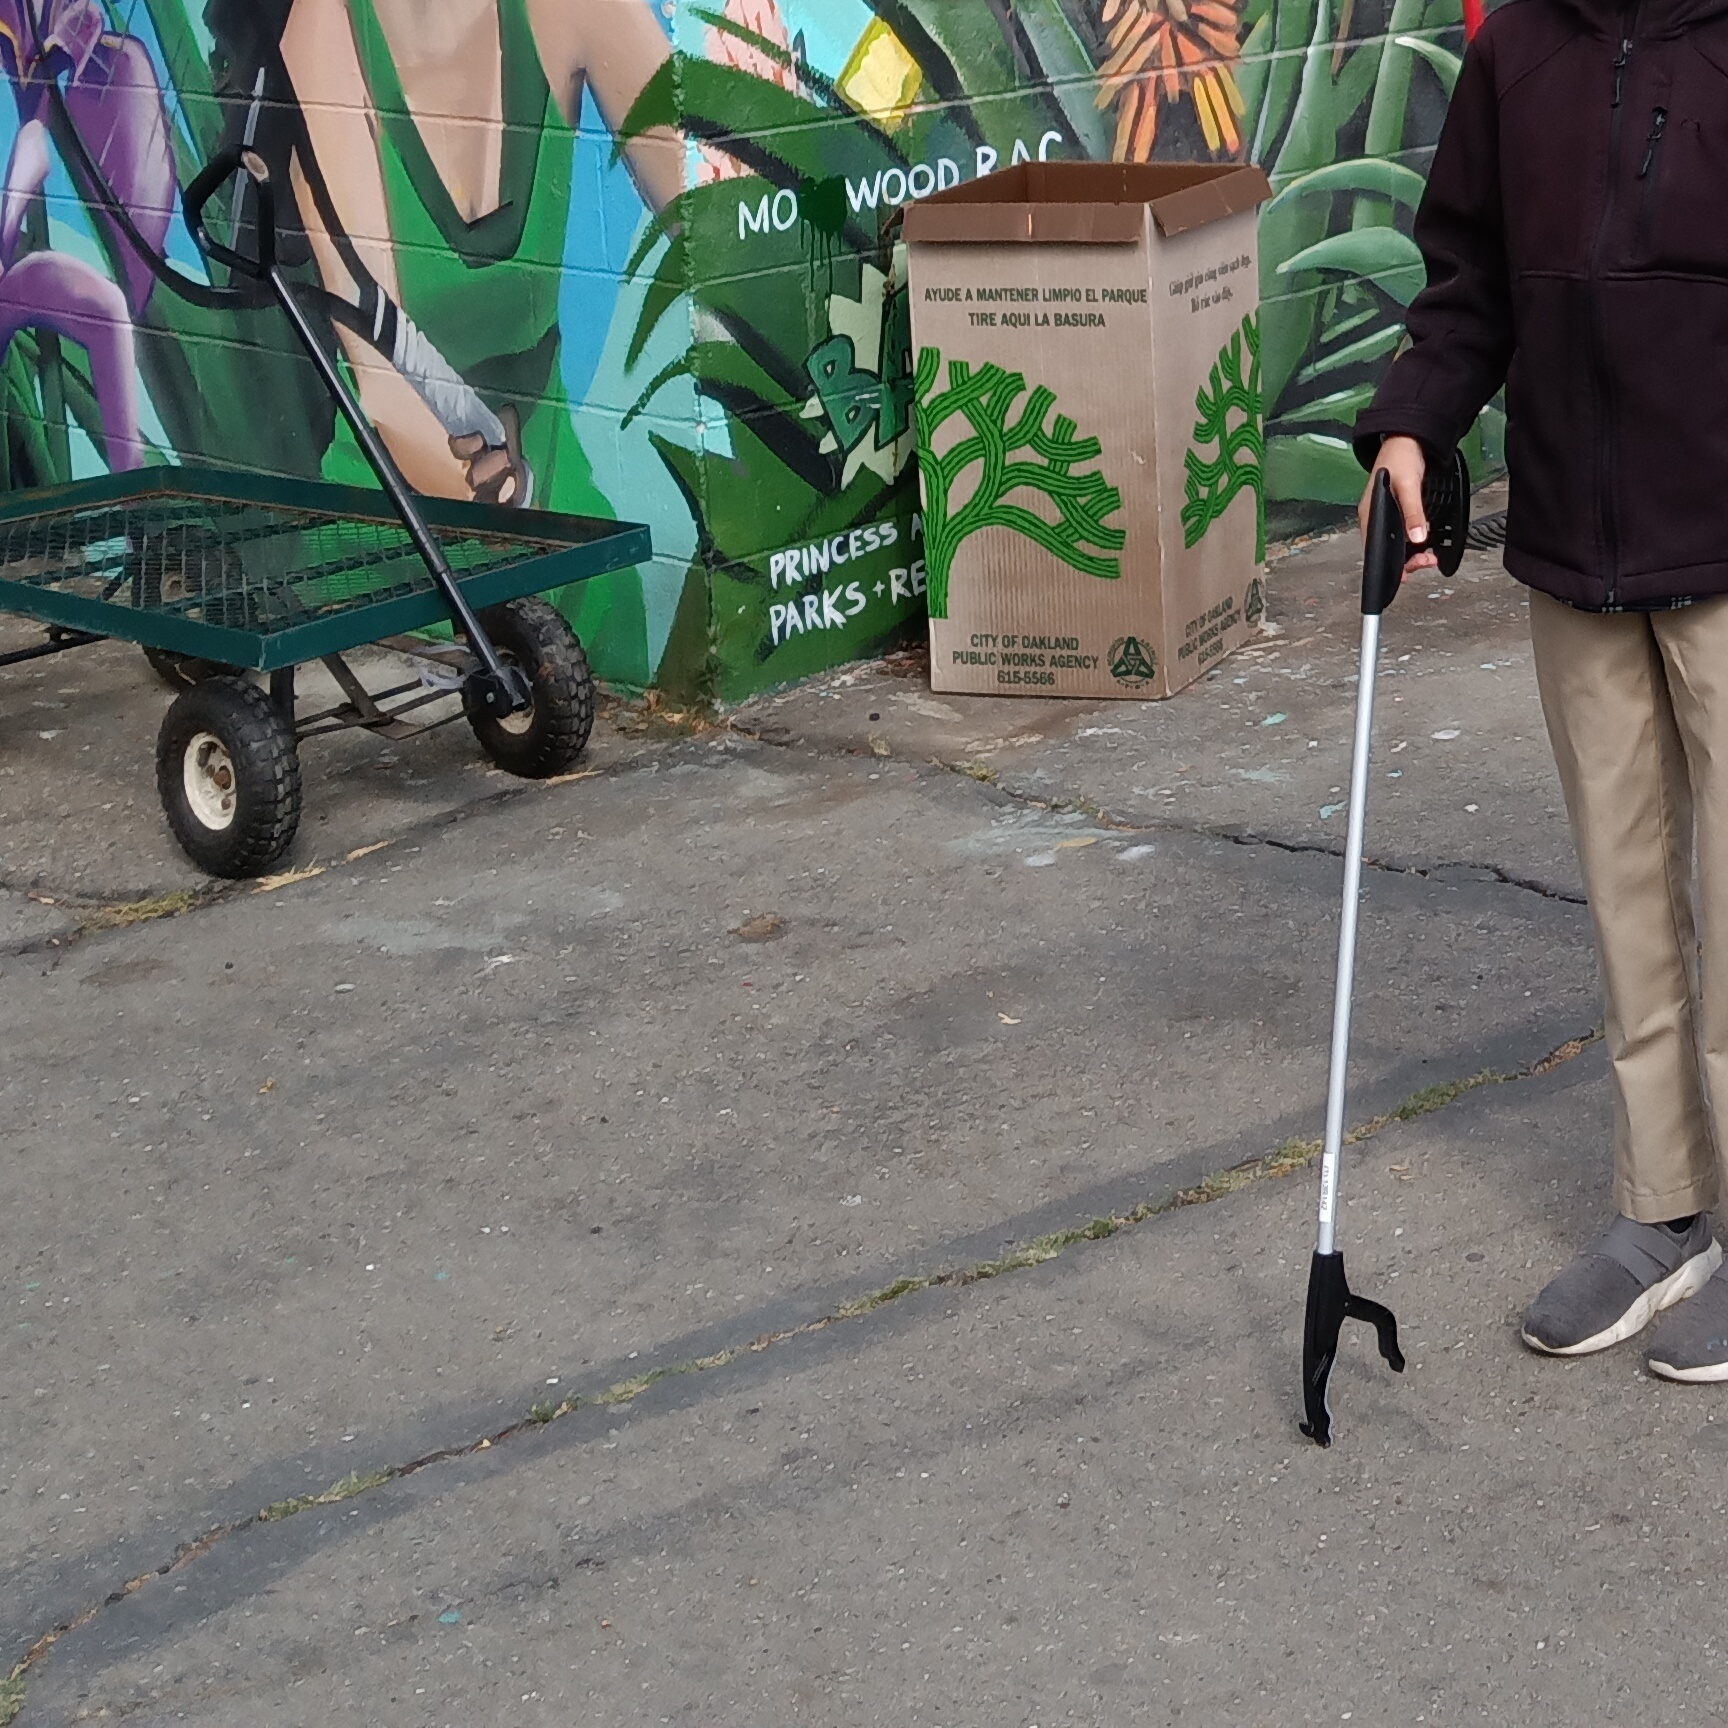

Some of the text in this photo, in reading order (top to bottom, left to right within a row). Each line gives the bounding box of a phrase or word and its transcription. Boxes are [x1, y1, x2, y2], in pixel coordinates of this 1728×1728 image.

[924, 287, 1148, 305] AYUDE A MANTENER LIMPIO EL PARQUE
[968, 312, 1106, 329] TIRE AQUI LA BASURA
[769, 522, 898, 591] PRINCESS
[769, 581, 867, 646] PARKS
[970, 633, 1079, 651] CITY OF OAKLAND
[952, 651, 1099, 669] PUBLIC WORKS AGENCY
[997, 670, 1055, 685] 615-5566
